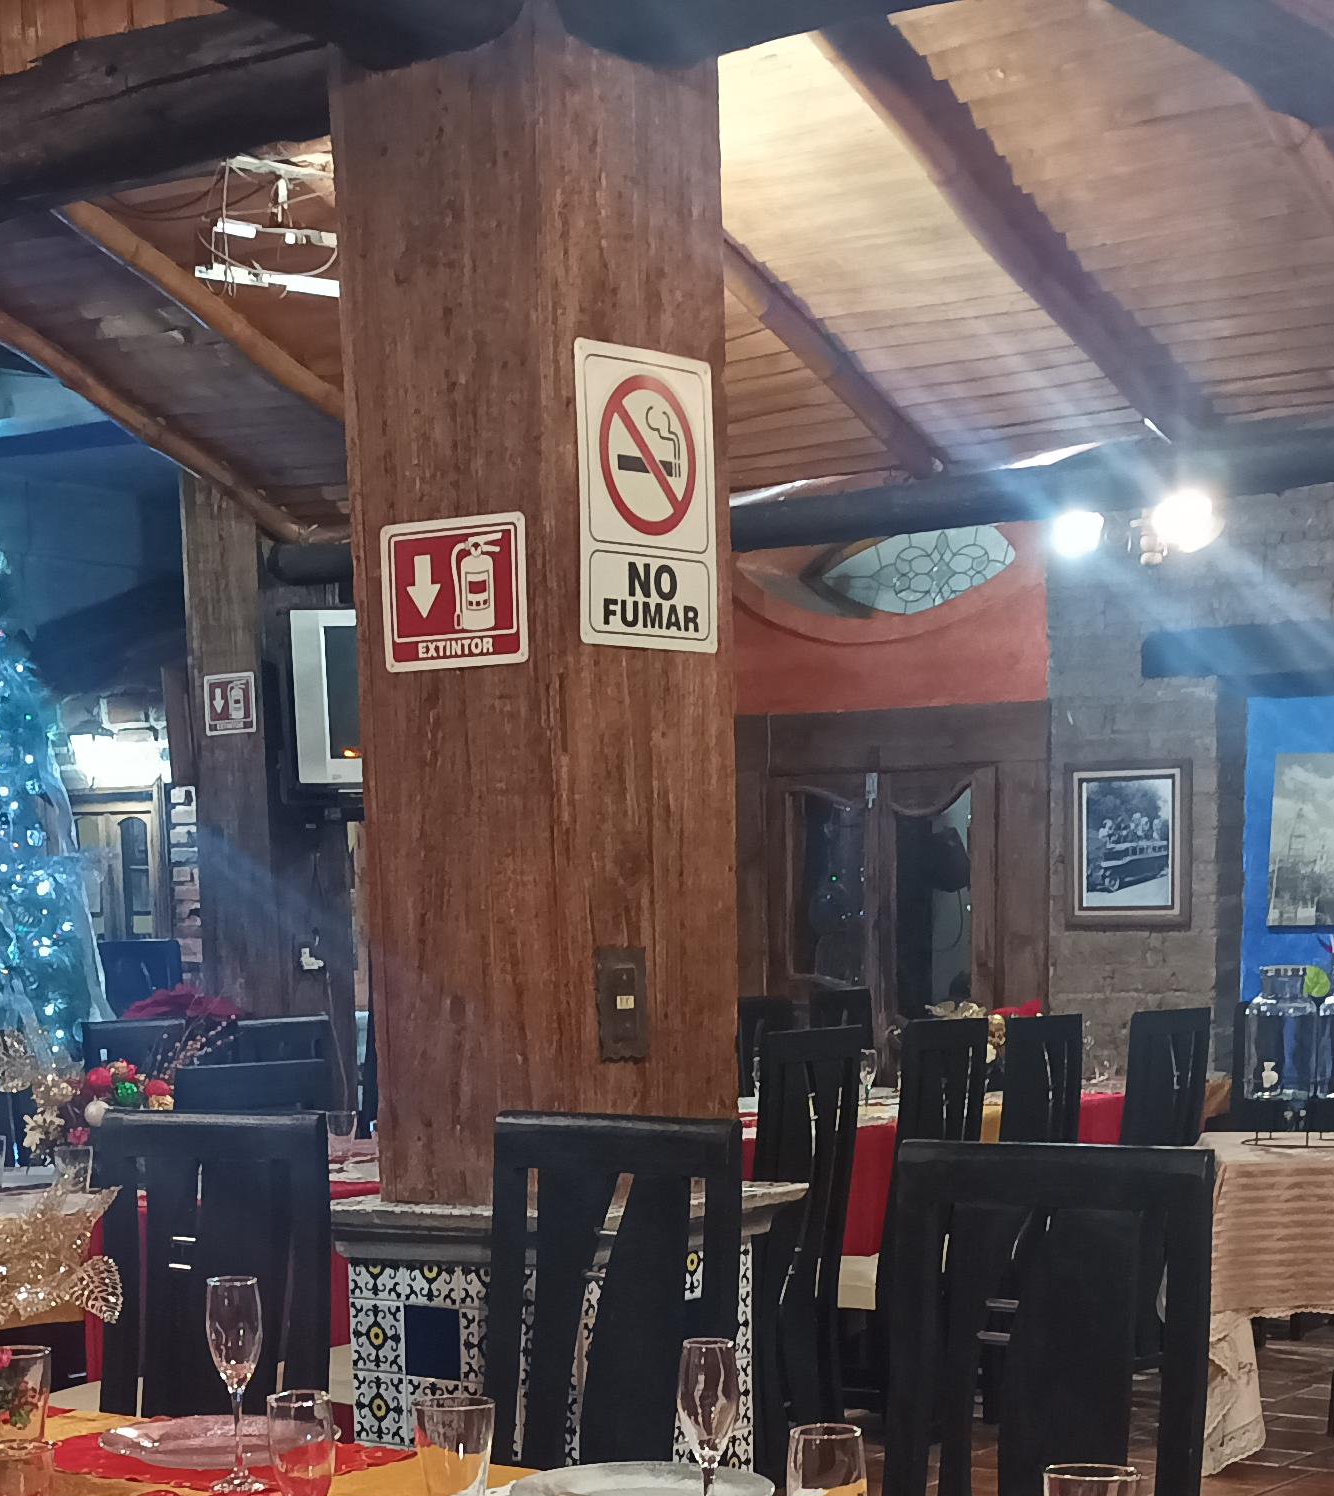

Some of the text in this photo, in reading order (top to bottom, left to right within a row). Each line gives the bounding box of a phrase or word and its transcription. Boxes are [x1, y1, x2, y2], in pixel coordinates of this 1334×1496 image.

[628, 561, 678, 601] NO
[603, 598, 699, 633] FUMAR
[418, 637, 494, 658] EXTINTOR
